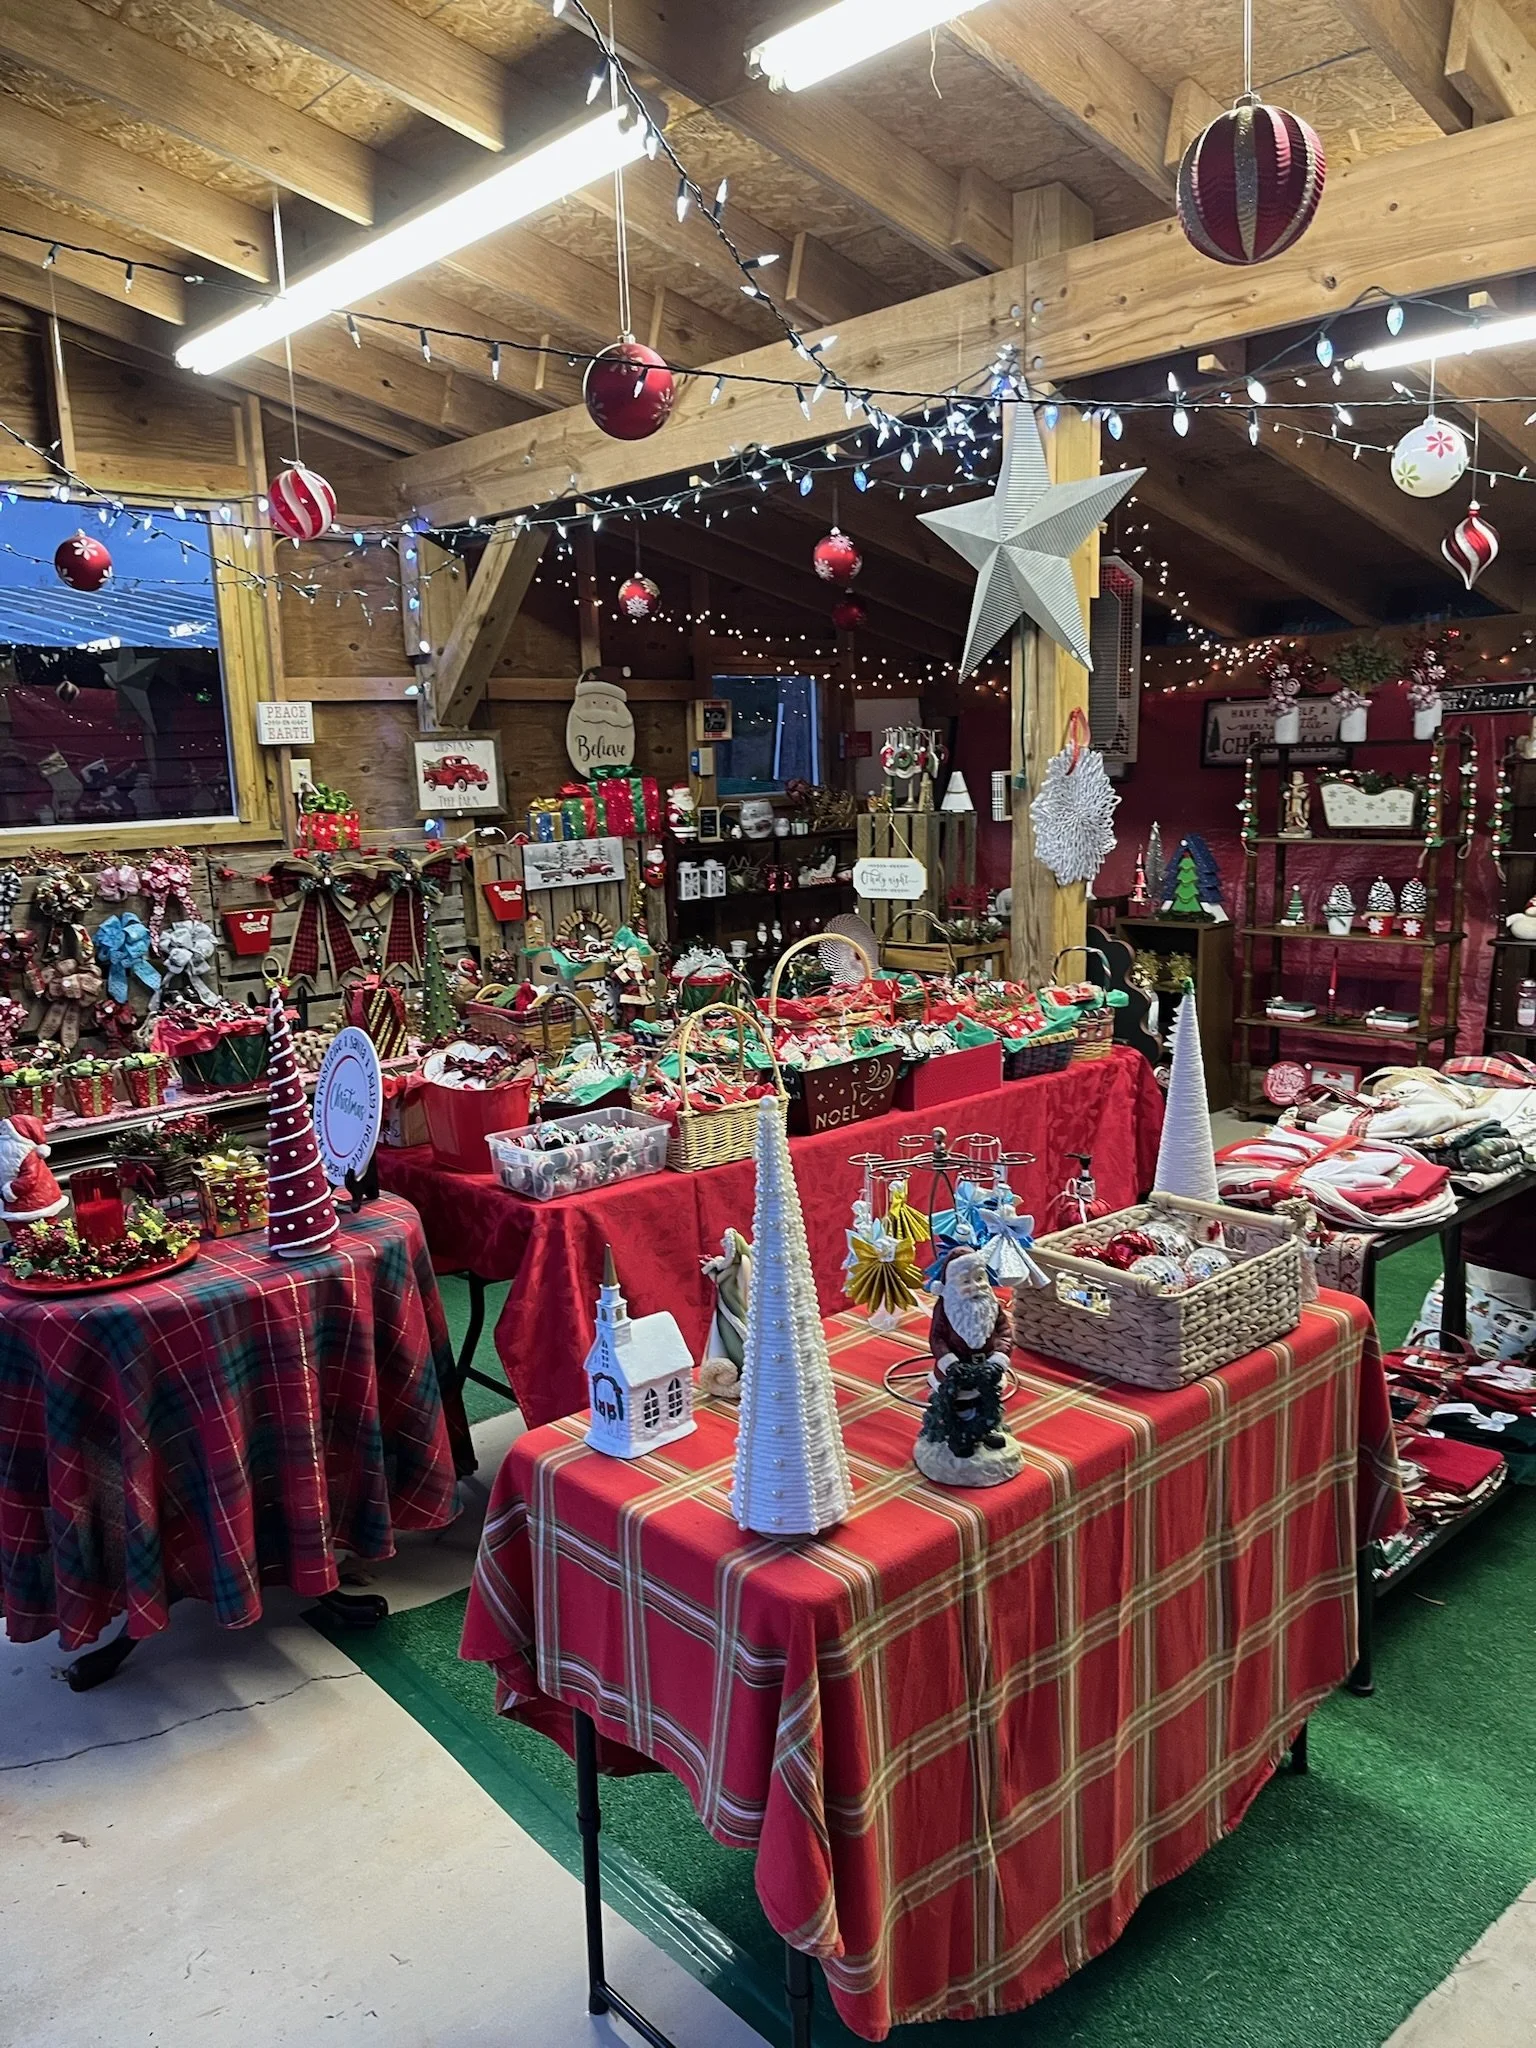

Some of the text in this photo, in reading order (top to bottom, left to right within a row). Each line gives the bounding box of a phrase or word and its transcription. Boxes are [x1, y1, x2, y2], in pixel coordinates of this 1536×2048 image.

[266, 706, 306, 718] PEACE
[1231, 708, 1259, 718] HAVE
[268, 726, 309, 739] EARTH
[575, 735, 627, 761] Believe
[330, 1082, 366, 1122] Christmas
[815, 1104, 860, 1130] NOEL
